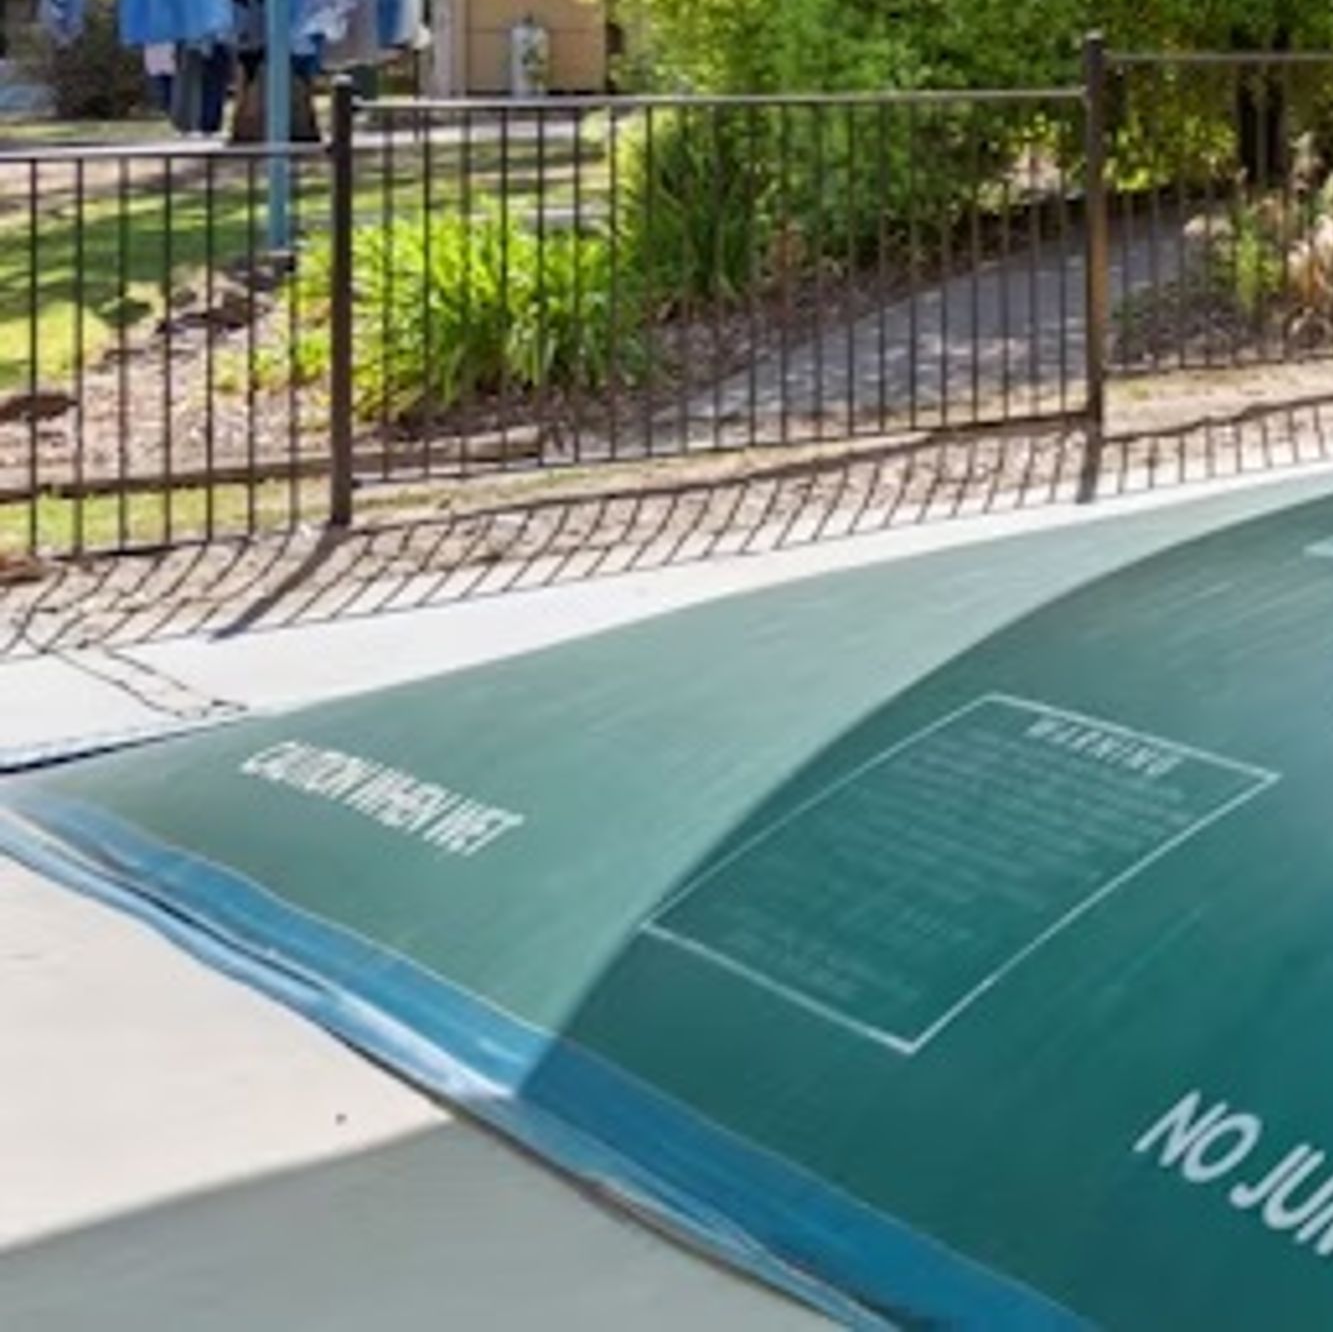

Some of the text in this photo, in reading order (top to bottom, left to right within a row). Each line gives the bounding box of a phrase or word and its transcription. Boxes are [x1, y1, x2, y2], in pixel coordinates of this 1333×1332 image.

[1025, 717, 1183, 777] WARNING
[240, 740, 525, 856] CAUTION WHEN WET
[1133, 1090, 1262, 1183] NO
